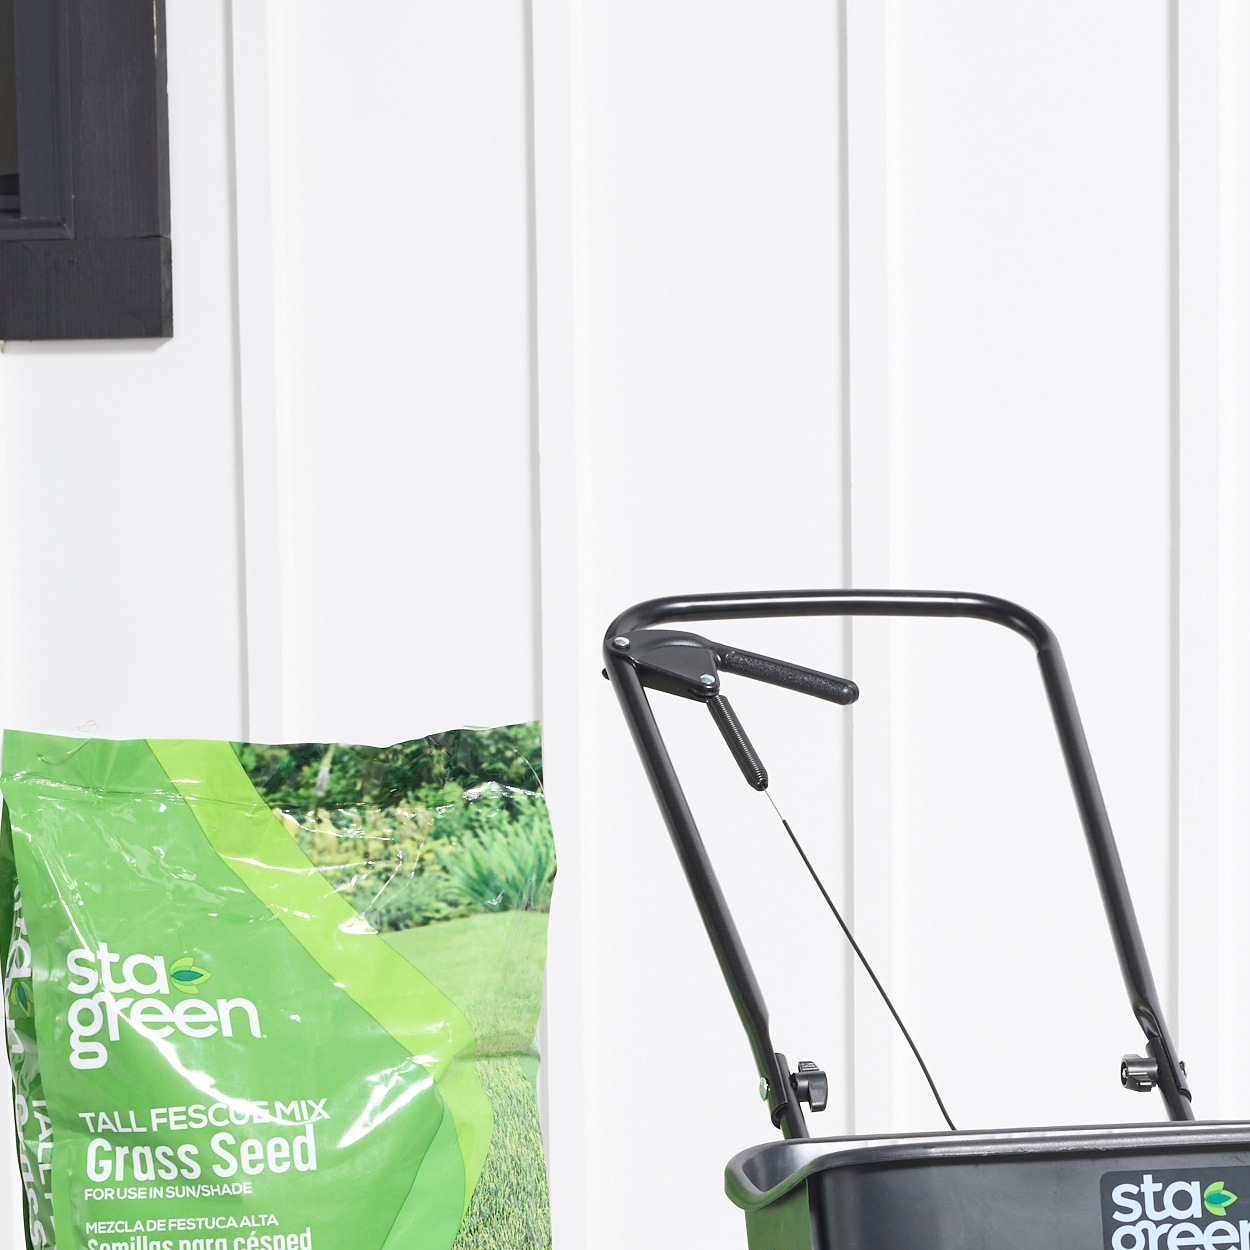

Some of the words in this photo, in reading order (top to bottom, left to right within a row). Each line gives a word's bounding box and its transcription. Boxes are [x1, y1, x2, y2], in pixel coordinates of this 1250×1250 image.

[66, 941, 170, 995] sta
[67, 992, 262, 1070] green
[78, 1110, 148, 1133] TALL
[150, 1100, 271, 1132] FESCUE
[274, 1097, 331, 1121] MIX
[86, 1137, 201, 1183] Grass
[210, 1123, 318, 1178] Seed
[84, 1187, 115, 1201] FOR
[117, 1187, 147, 1200] USE
[149, 1186, 164, 1199] IN
[165, 1181, 253, 1199] SUN/SHADE
[1111, 1174, 1203, 1223] sta
[85, 1220, 145, 1235] MEZCLA
[146, 1218, 167, 1232] DE
[168, 1216, 239, 1231] FESTUCA
[239, 1213, 279, 1228] ALTA
